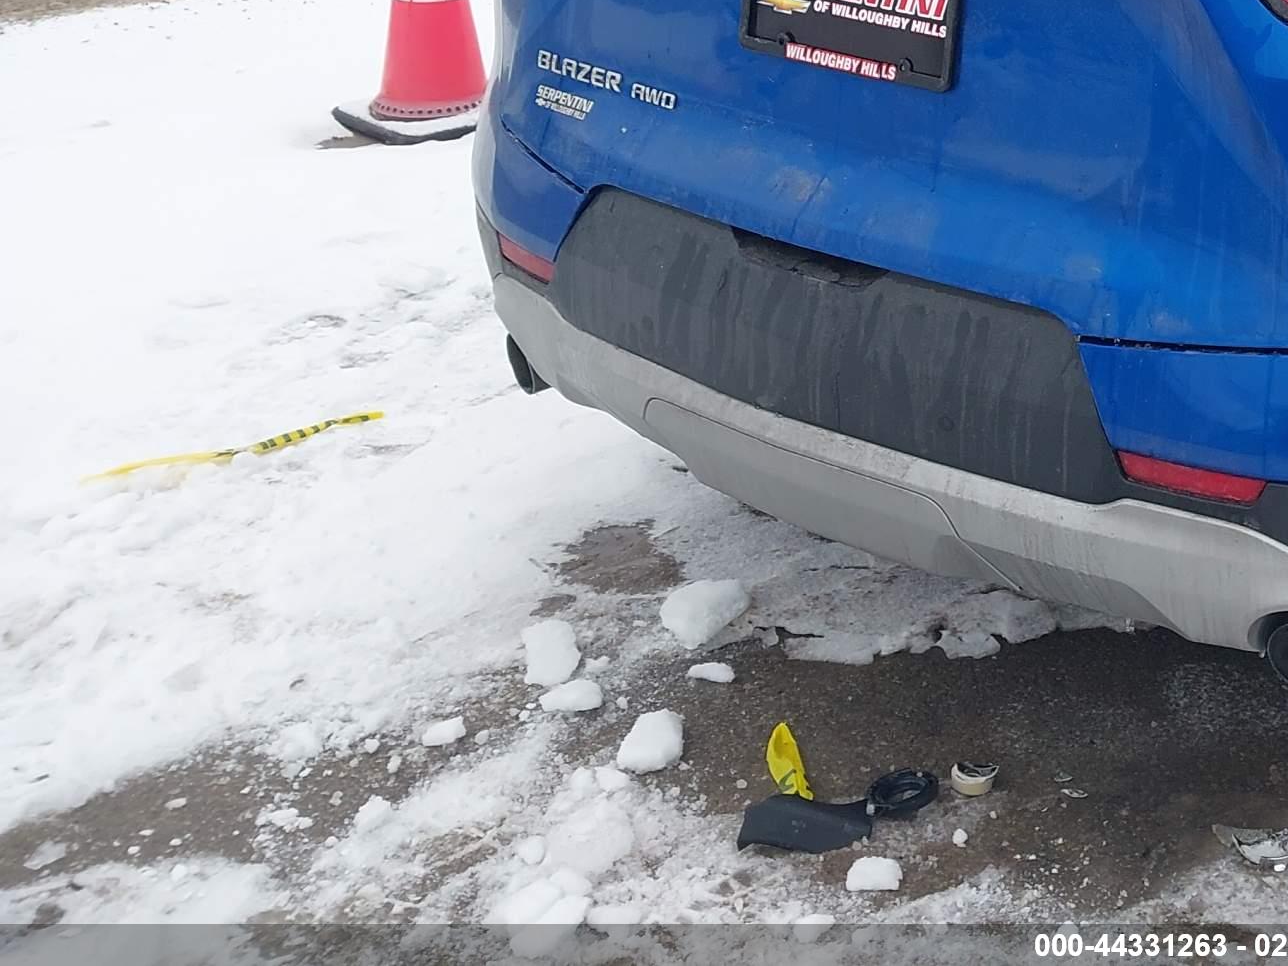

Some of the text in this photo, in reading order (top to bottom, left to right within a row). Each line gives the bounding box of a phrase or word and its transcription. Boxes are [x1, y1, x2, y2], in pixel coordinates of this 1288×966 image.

[813, 0, 948, 39] OF WILLOUGHBY HILLS
[537, 49, 677, 110] BLAZER AWD
[785, 43, 898, 80] WILLOUGHBY HILLS
[535, 84, 595, 114] SERPENTINI
